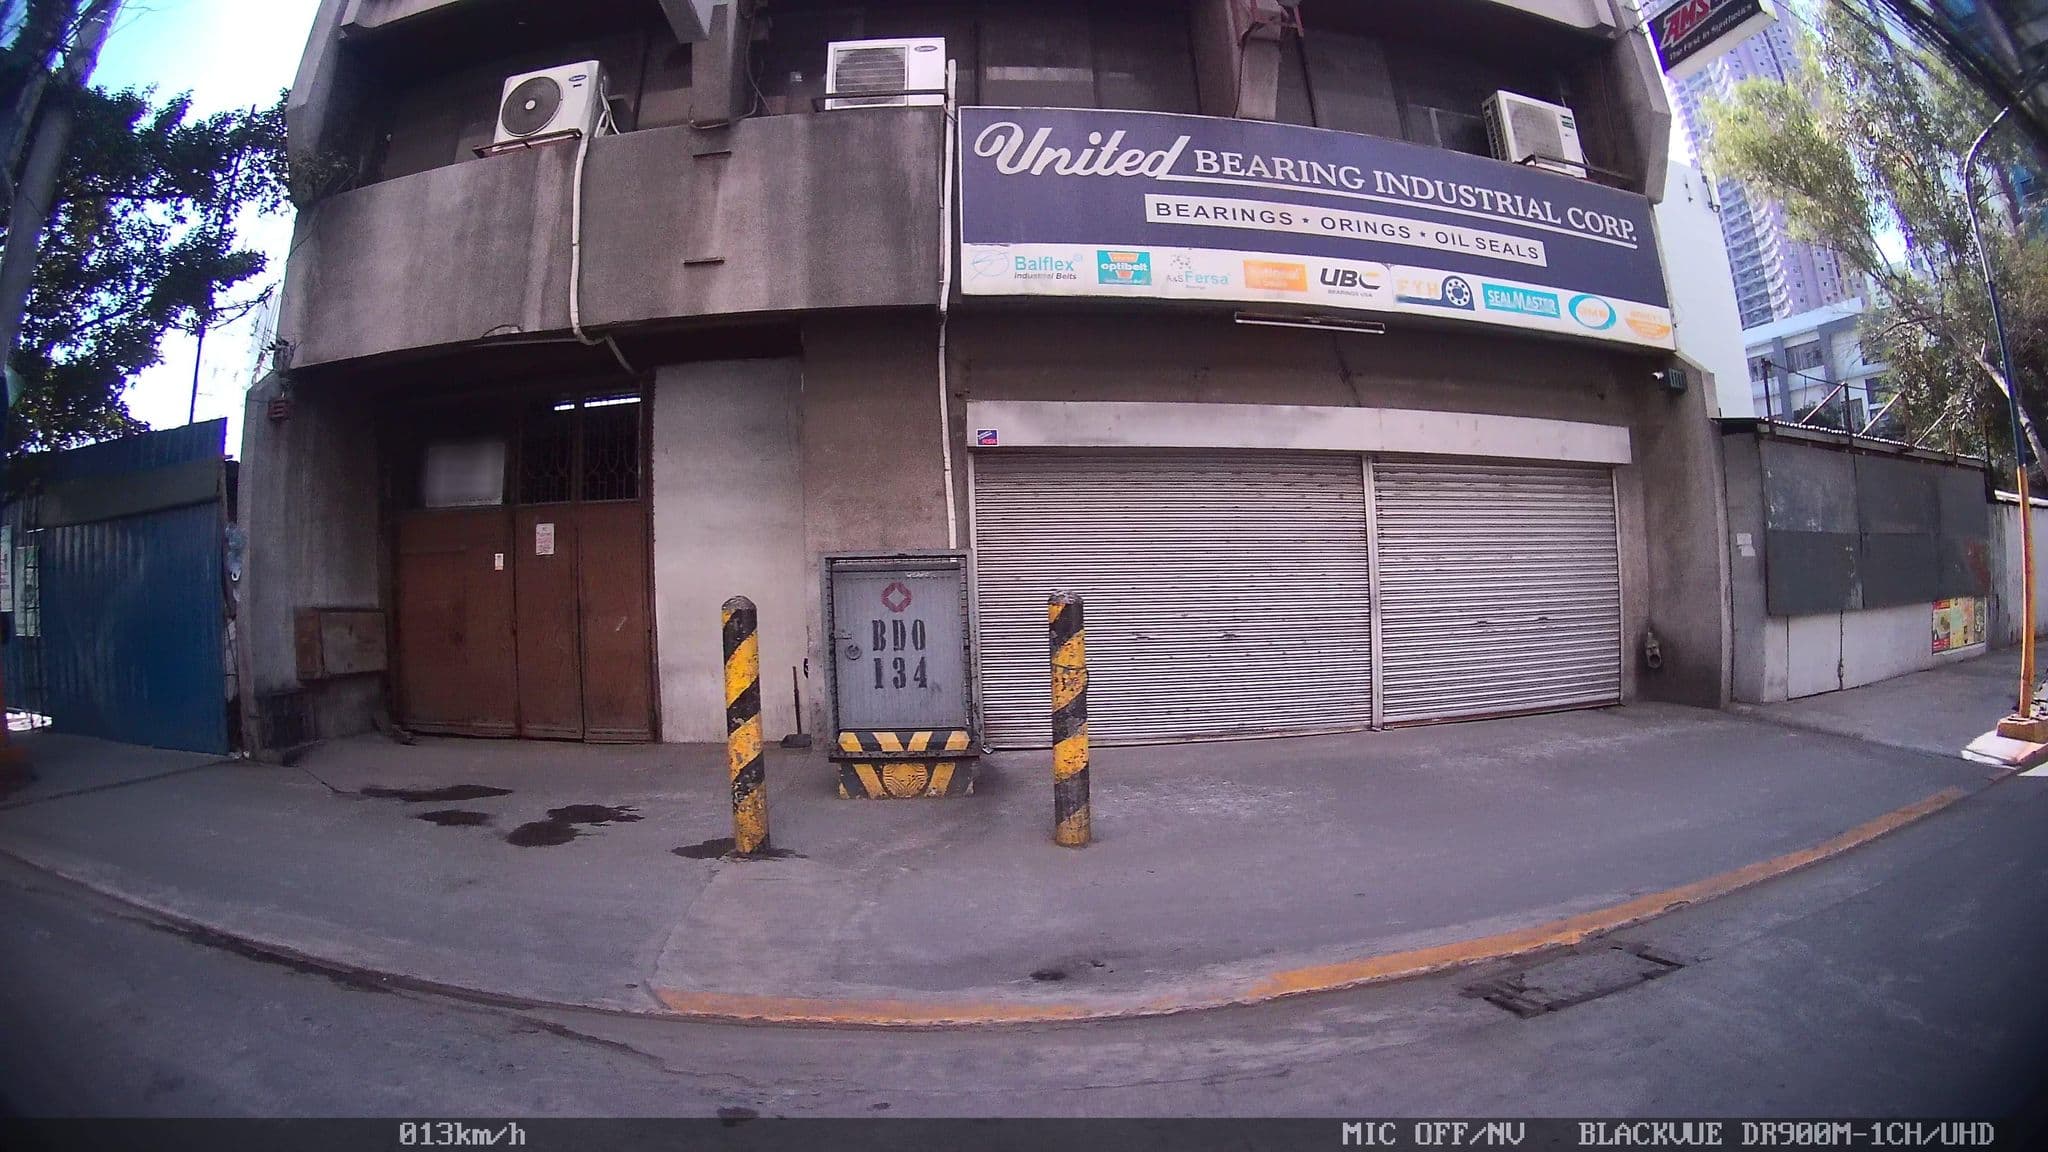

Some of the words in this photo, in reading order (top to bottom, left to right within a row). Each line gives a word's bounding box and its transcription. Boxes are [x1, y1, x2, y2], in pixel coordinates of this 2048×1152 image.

[974, 122, 1191, 180] United
[1194, 149, 1365, 190] BEARING
[1373, 170, 1562, 225] INDUSTRIAL
[1567, 206, 1638, 242] CORP.
[1156, 202, 1293, 226] BEARINGS
[1320, 216, 1411, 239] ORINGS
[1434, 230, 1470, 248] OIL
[1475, 237, 1539, 260] SEALS
[1014, 255, 1075, 271] Balflex
[1100, 261, 1149, 273] optibelt
[1055, 272, 1078, 280] Belts
[1185, 270, 1229, 285] Fersa
[1320, 267, 1381, 291] UBC
[872, 619, 927, 651] BDO
[873, 656, 928, 690] 134
